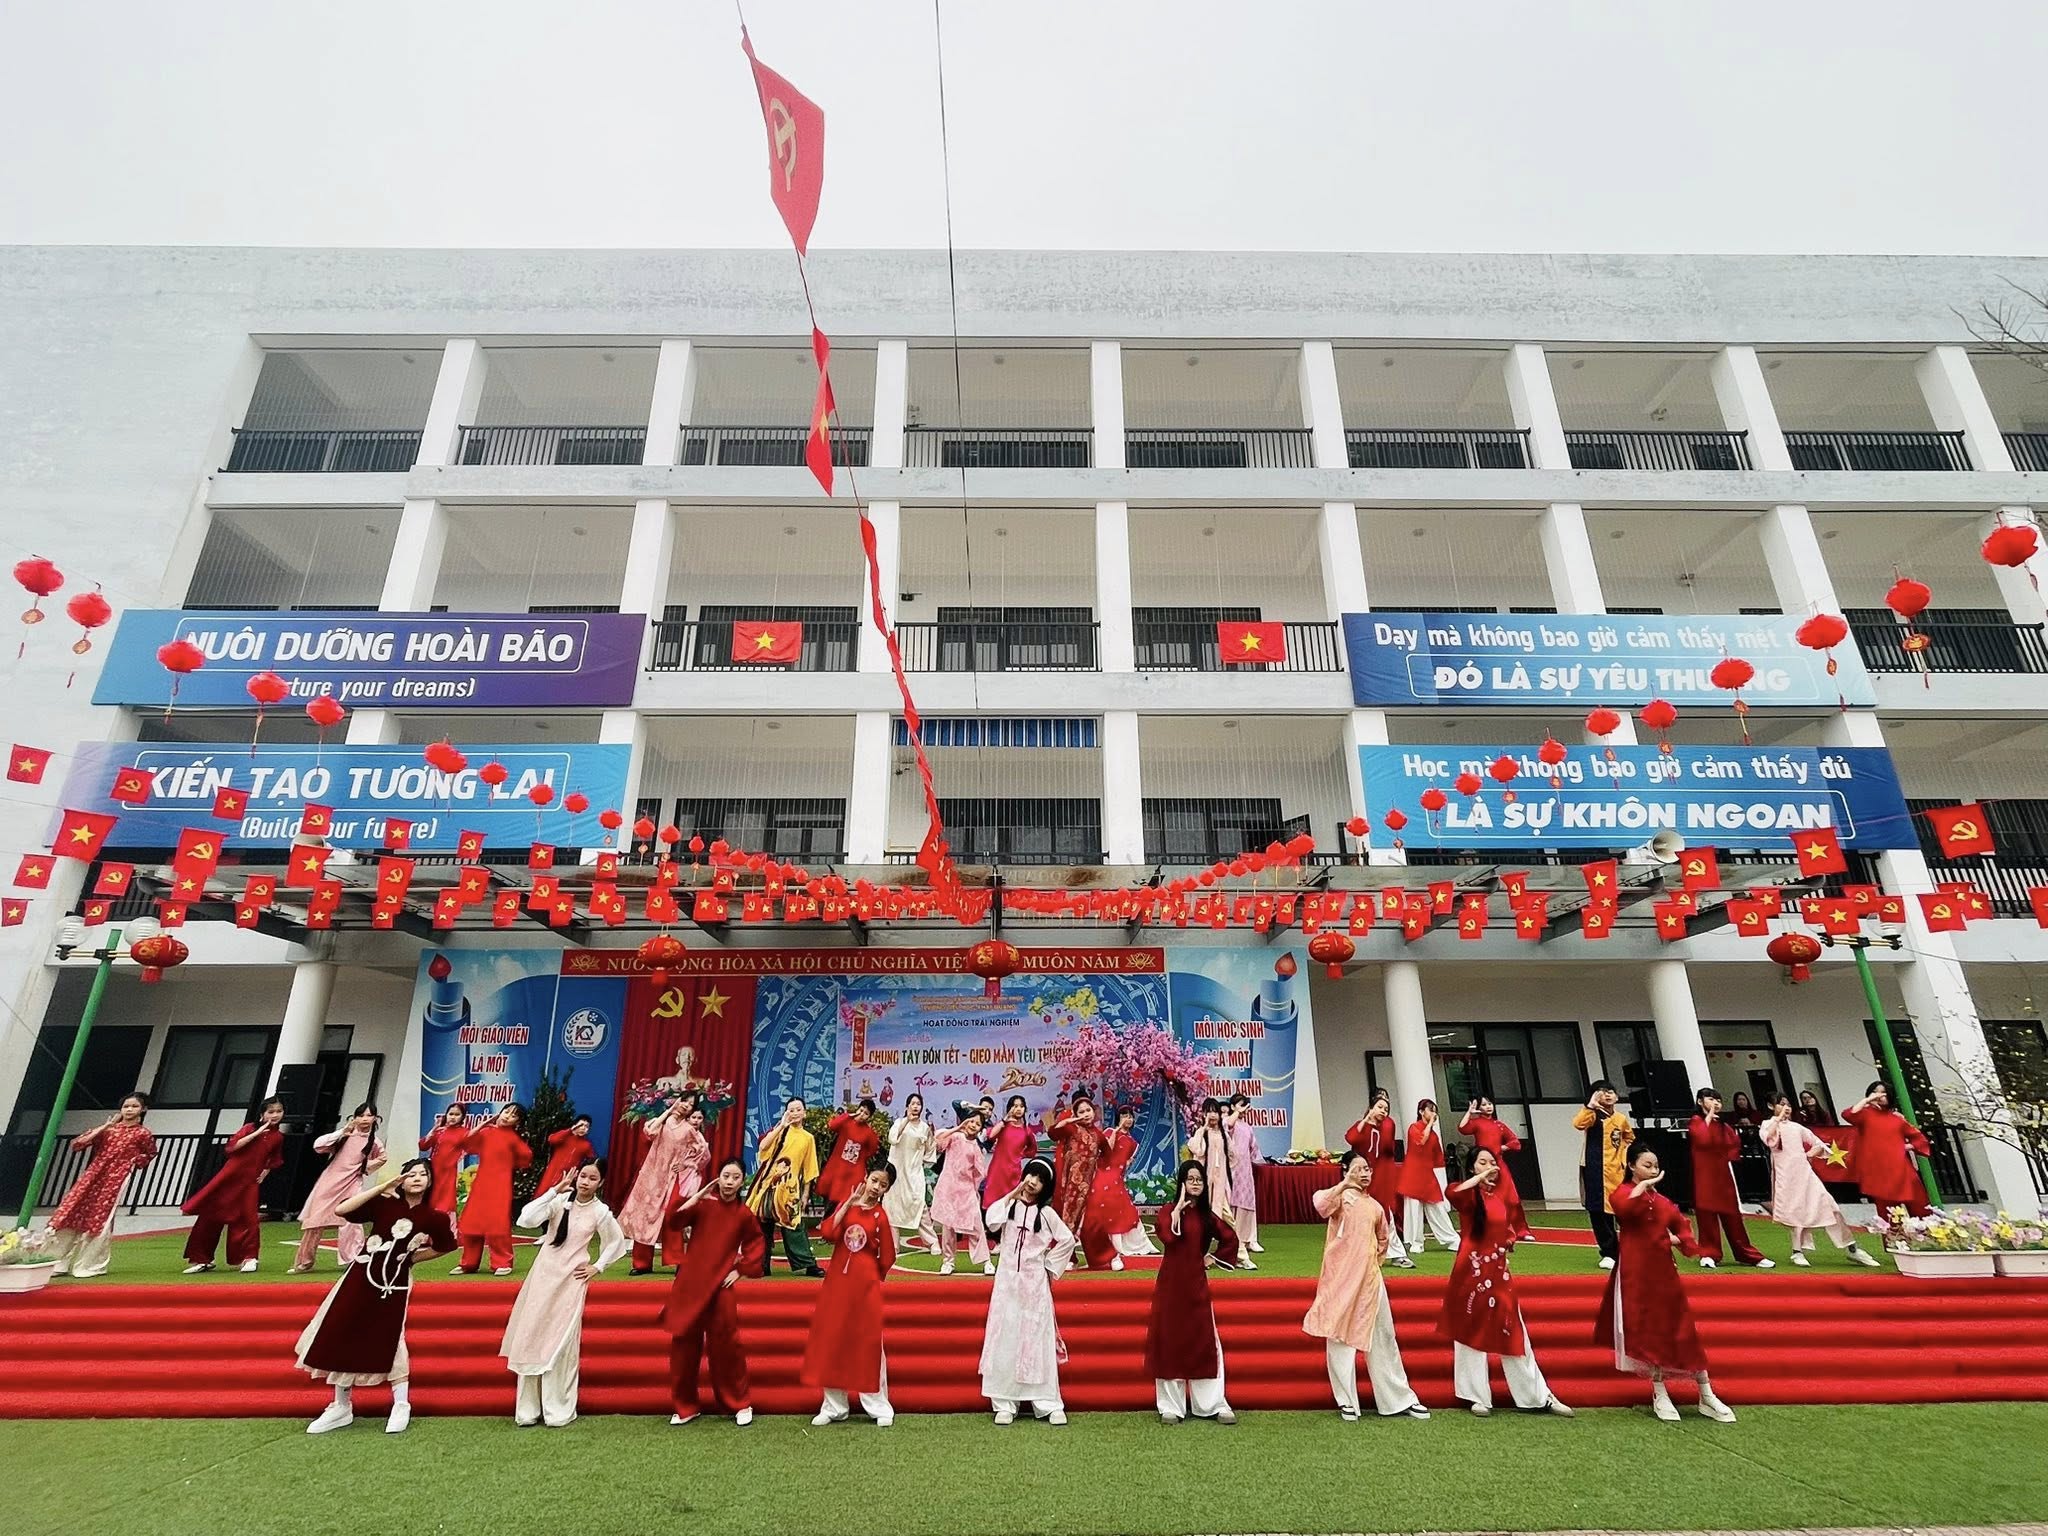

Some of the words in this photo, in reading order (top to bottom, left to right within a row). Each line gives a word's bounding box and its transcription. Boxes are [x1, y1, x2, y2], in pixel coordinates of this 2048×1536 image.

[188, 626, 266, 661] NUÔI
[274, 627, 395, 661] DƯỠNG
[404, 627, 490, 662] HOÀI
[499, 629, 574, 662] BÃO
[1374, 623, 1418, 651] Dạy
[1427, 624, 1462, 646] mà
[1467, 624, 1535, 652] không
[1539, 625, 1580, 647] bao
[1587, 626, 1619, 653] giờ
[1626, 625, 1671, 648] cảm
[1676, 624, 1726, 654] thấy
[338, 681, 386, 700] your
[391, 677, 476, 697] dreams)
[1433, 660, 1484, 690] ĐÓ
[1492, 661, 1532, 690] LÀ
[1539, 663, 1583, 697] SỰ
[1587, 662, 1648, 691] YÊU
[1402, 754, 1450, 783] Học
[1590, 754, 1636, 778] bao
[1646, 756, 1682, 784] giờ
[1691, 755, 1743, 779] cảm
[1750, 754, 1808, 784] thấy
[1819, 755, 1853, 779] đủ
[147, 757, 234, 798] KIẾN
[249, 767, 331, 806] TẠO
[348, 765, 478, 800] TƯƠNG
[1445, 796, 1494, 828] LÀ
[1502, 797, 1557, 836] SỰ
[1562, 796, 1676, 829] KHÔN
[1687, 803, 1831, 829] NGOAN
[363, 817, 438, 839] fure)
[718, 953, 757, 971] HÒA
[760, 953, 785, 970] XÃ
[789, 952, 822, 973] HỘI
[870, 953, 928, 970] NGHĨA
[1022, 952, 1076, 969] MUÔN
[1080, 953, 1120, 969] NĂM
[481, 1024, 504, 1043] GIÁO
[506, 1024, 528, 1043] VIÊN
[1217, 1022, 1237, 1041] HỌC
[1240, 1022, 1264, 1038] SINH
[486, 1053, 508, 1076] MỘT
[869, 1049, 899, 1064] CHUNG
[902, 1049, 920, 1064] TAY
[922, 1046, 941, 1064] ĐÓN
[943, 1044, 960, 1064] TẾT
[969, 1048, 991, 1063] GIEO
[1228, 1047, 1250, 1070] MỘT
[1234, 1079, 1262, 1096] XANH
[1271, 1109, 1286, 1126] LAI
